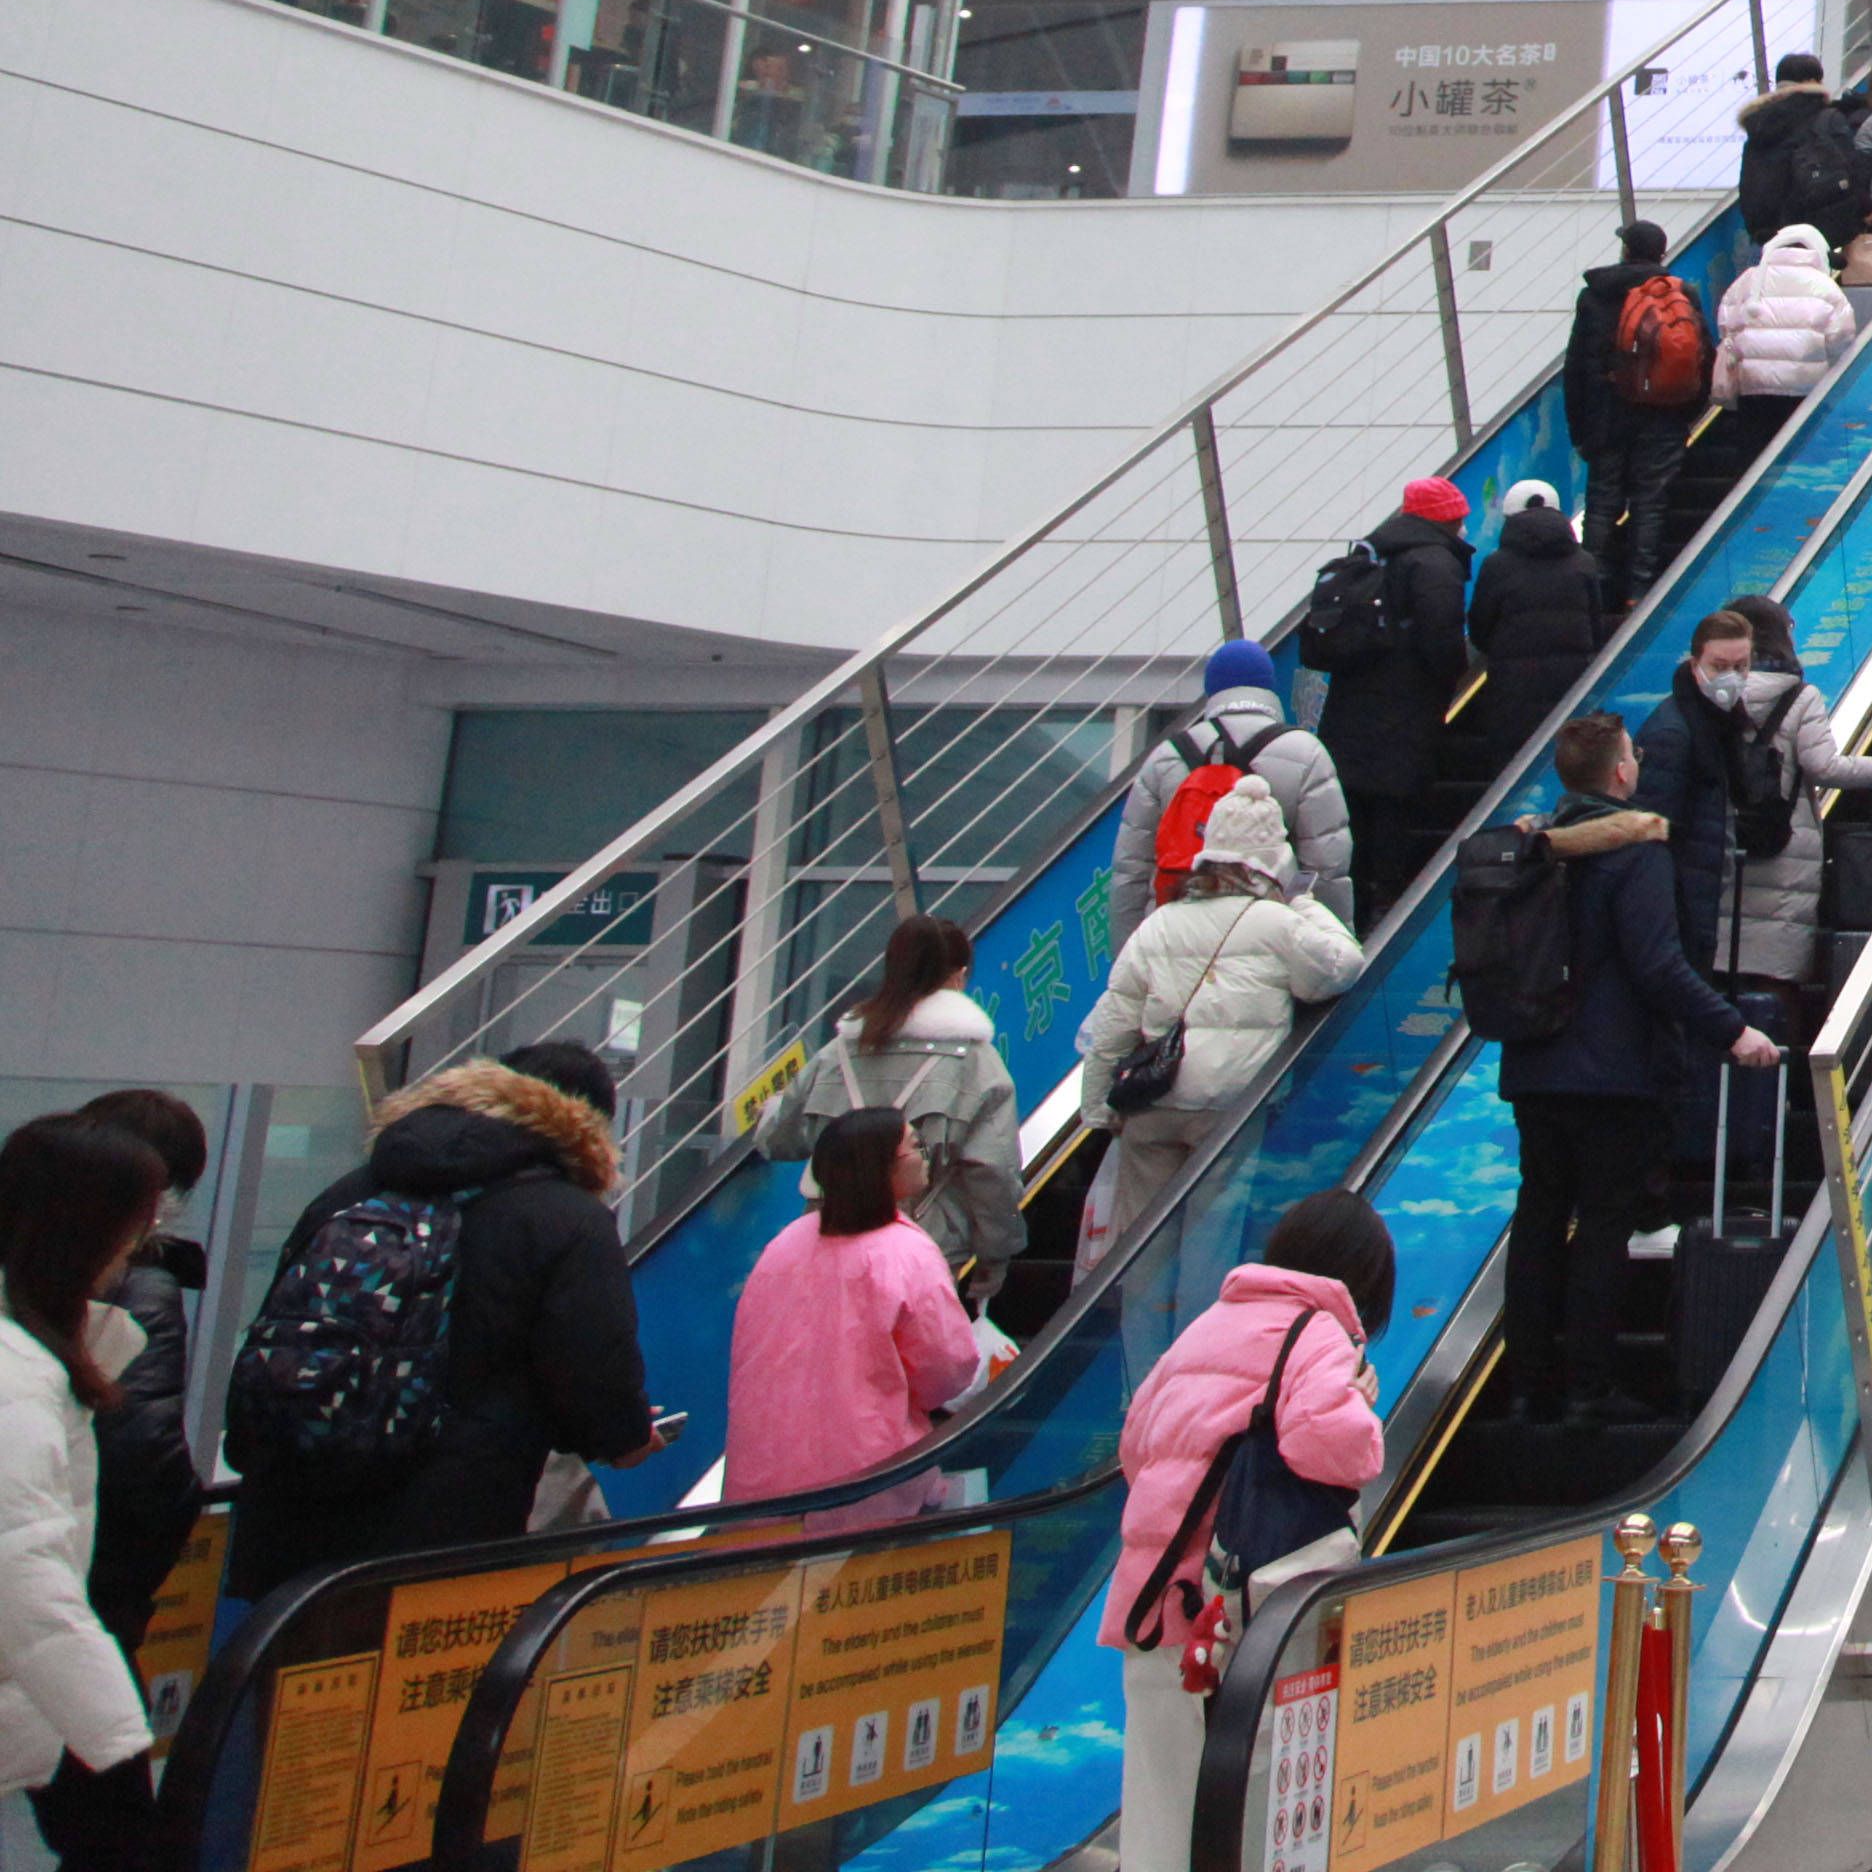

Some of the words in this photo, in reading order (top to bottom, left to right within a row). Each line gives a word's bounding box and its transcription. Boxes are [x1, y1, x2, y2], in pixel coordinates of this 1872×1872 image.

[1390, 79, 1520, 118] 小罐茶
[650, 1605, 790, 1664] 请您扶好扶手带
[1350, 1608, 1448, 1670] 请您扶好扶手带
[652, 1660, 773, 1720] 注意乘梯安全
[1353, 1663, 1438, 1724] 注意乘梯安全
